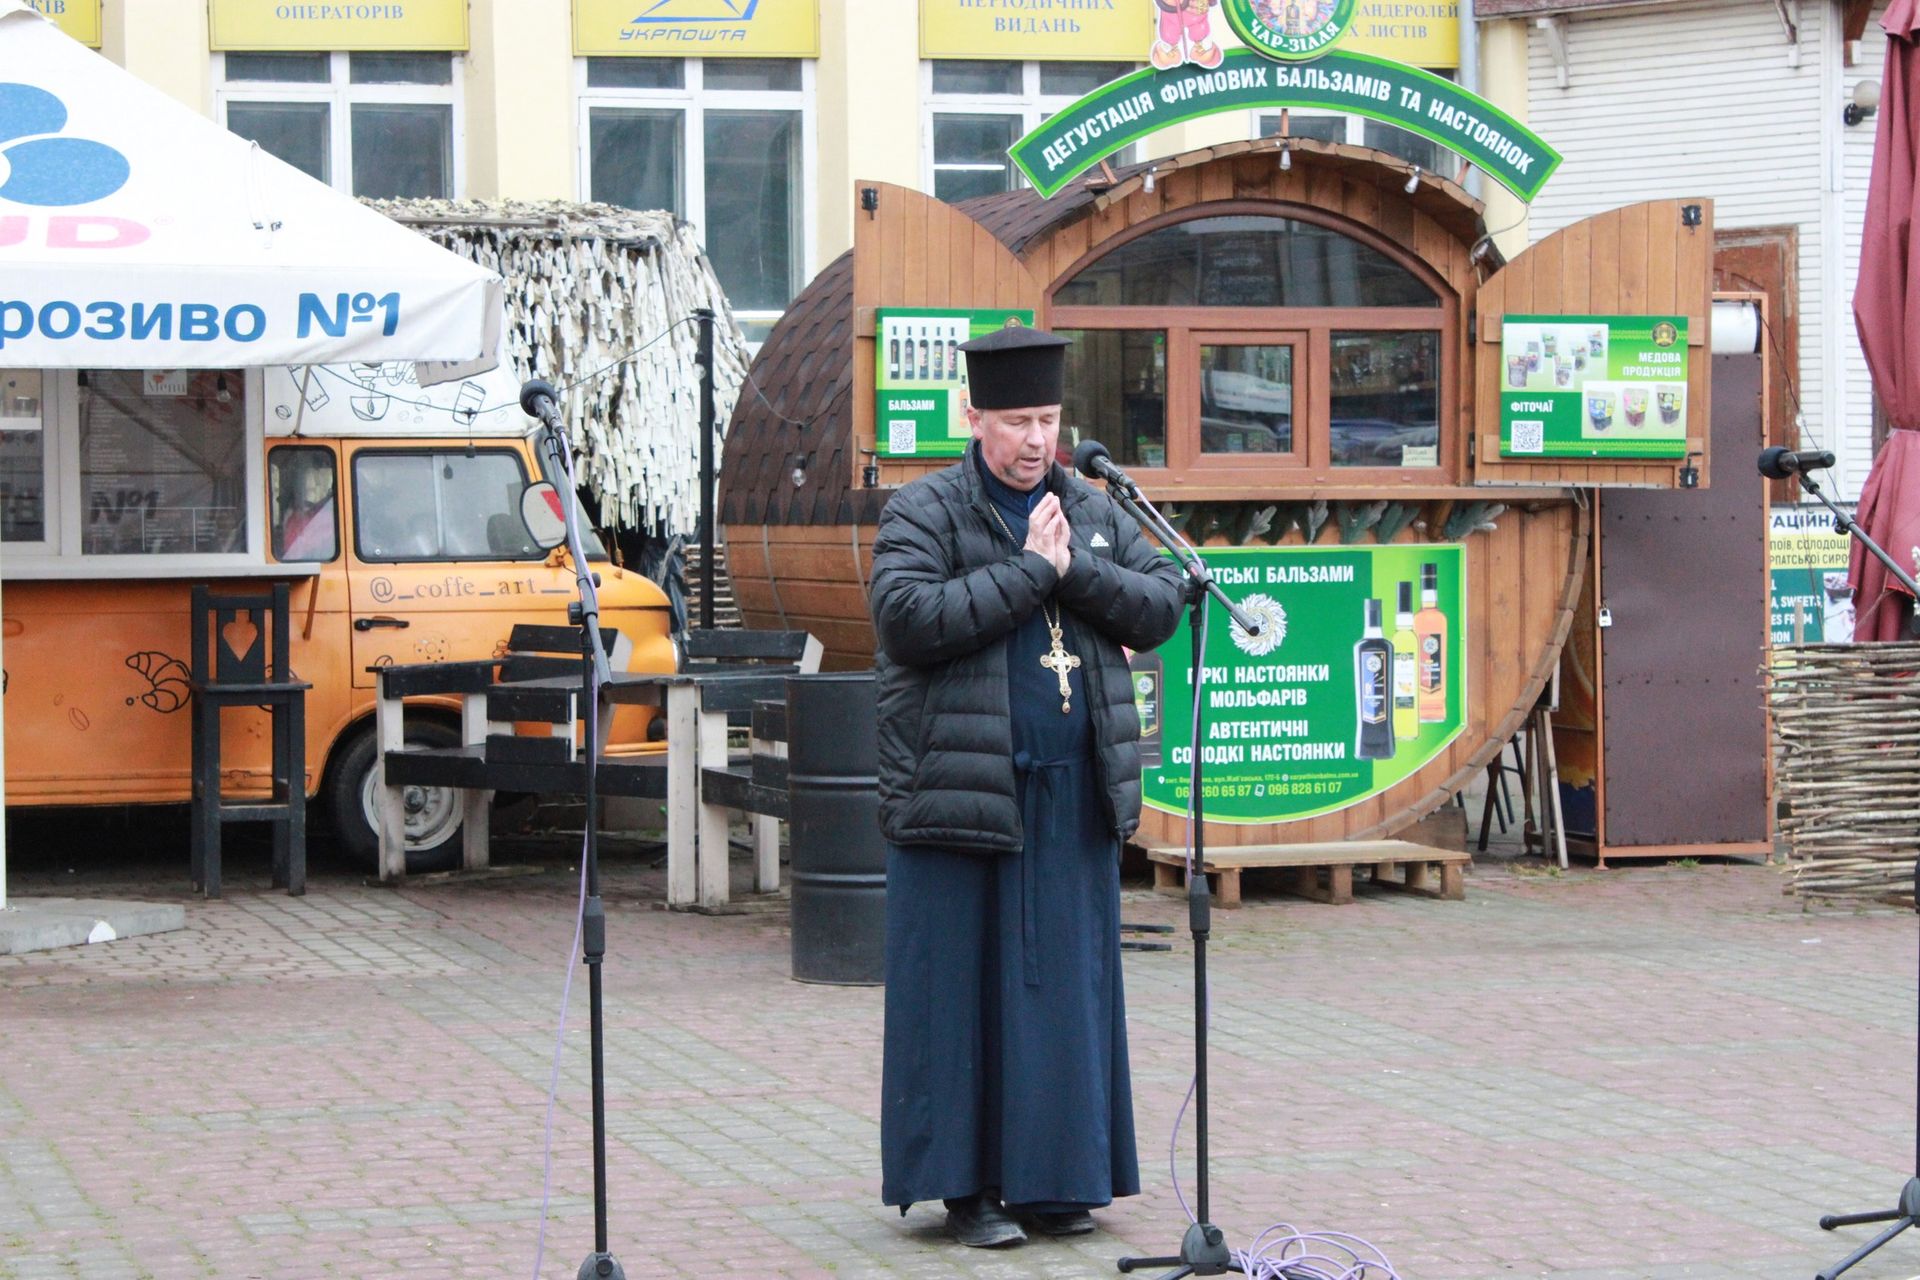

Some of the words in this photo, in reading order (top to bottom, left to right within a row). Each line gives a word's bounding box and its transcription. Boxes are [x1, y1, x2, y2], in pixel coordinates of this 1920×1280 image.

[276, 5, 404, 19] ОПЕРАТОРІВ
[1356, 2, 1459, 18] АНДЕРОЛЕЙ
[994, 17, 1081, 34] ВИДАНЬ
[1366, 24, 1429, 39] ЛИСТІВ
[619, 28, 747, 41] УКРПОШТА
[1042, 91, 1155, 171] ДЕГУСТАЦІЯ
[1160, 67, 1268, 104] ФІРМОВИХ
[1276, 67, 1391, 101] БАЛЬЗАМІВ
[1400, 86, 1422, 112] ТА
[1427, 98, 1535, 176] НАСТОЯНОК
[1638, 352, 1681, 364] МЕДОВА
[1622, 366, 1681, 378] ПРОДУКЦІЯ
[888, 399, 935, 411] БАЛЬЗАМИ
[1510, 399, 1554, 413] ФІТОЧАЇ
[1769, 511, 1837, 530] АЦІЙН
[1822, 554, 1850, 565] СИРО
[1266, 565, 1354, 584] БАЛЬЗАМИ
[1784, 612, 1813, 625] FRM
[1187, 666, 1228, 685] ГРКІ
[1234, 664, 1330, 683] НАСТОЯНКИ
[1210, 689, 1308, 708] МОЛЬФАРІВ
[1209, 720, 1309, 739] АВТЕНТИЧНІ
[1251, 742, 1346, 762] НАСТОЯНКИ
[1221, 785, 1236, 797] 65
[1237, 784, 1251, 797] 87
[1268, 783, 1289, 796] 096
[1291, 782, 1312, 795] 828
[1314, 782, 1327, 794] 61
[1328, 781, 1342, 794] 07
